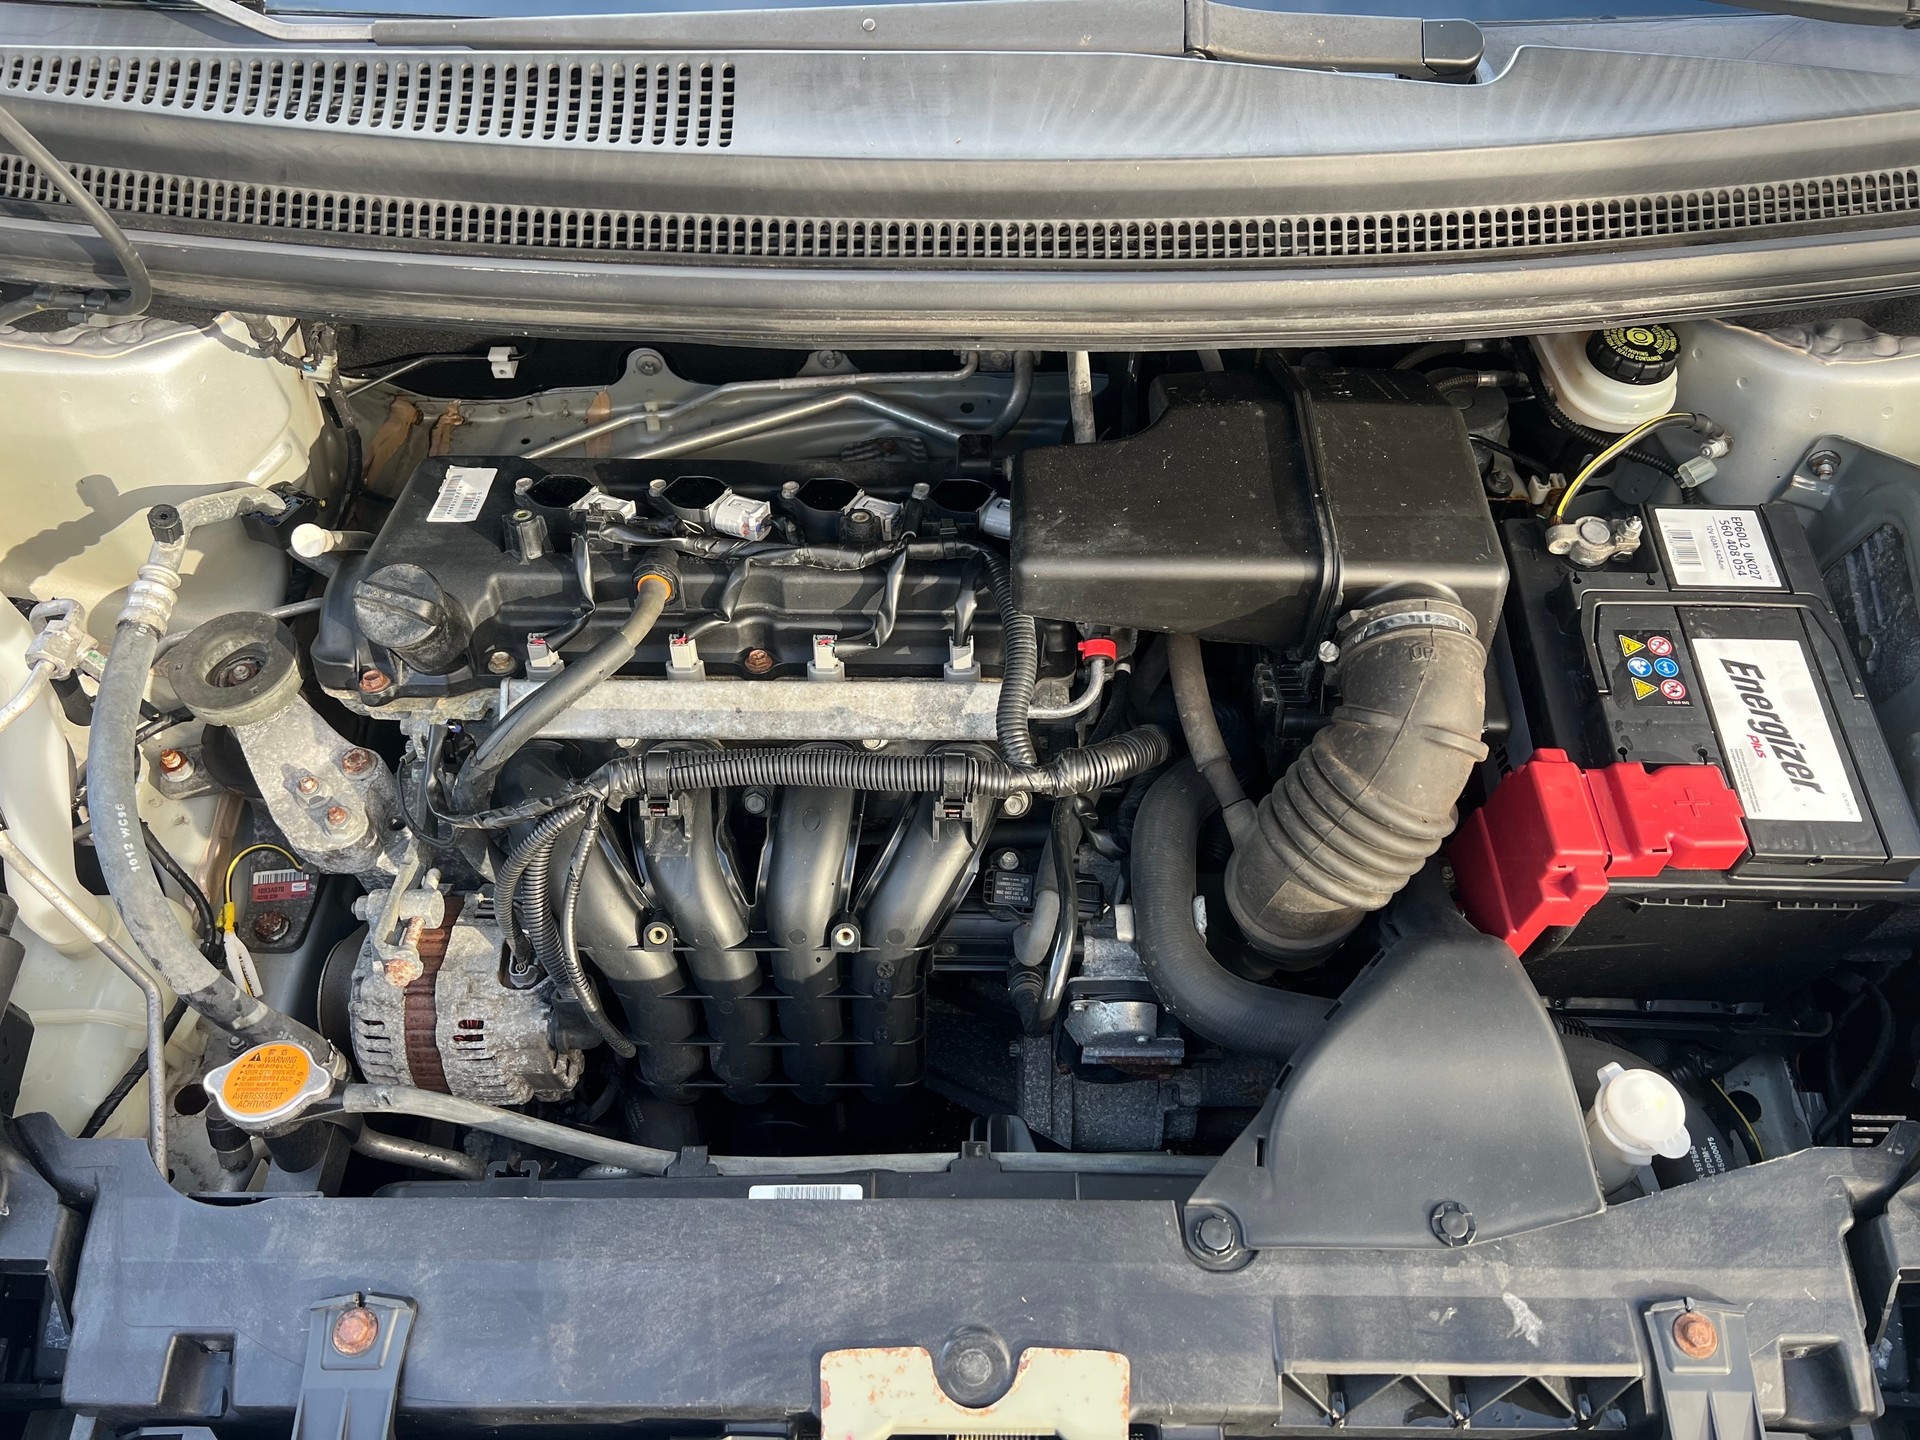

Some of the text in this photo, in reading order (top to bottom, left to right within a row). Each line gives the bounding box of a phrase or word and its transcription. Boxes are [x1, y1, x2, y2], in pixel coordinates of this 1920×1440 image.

[1615, 347, 1635, 359] SEALED
[1719, 520, 1747, 576] 560 408 054
[1731, 516, 1762, 580] EP60L2 UK027
[1719, 657, 1826, 795] Energizer
[1746, 734, 1767, 758] plus
[123, 842, 141, 873] 1012
[264, 1056, 298, 1064] WARNING
[232, 1092, 284, 1100] AVERTISSEMENT
[237, 1100, 272, 1108] ACHTUNG
